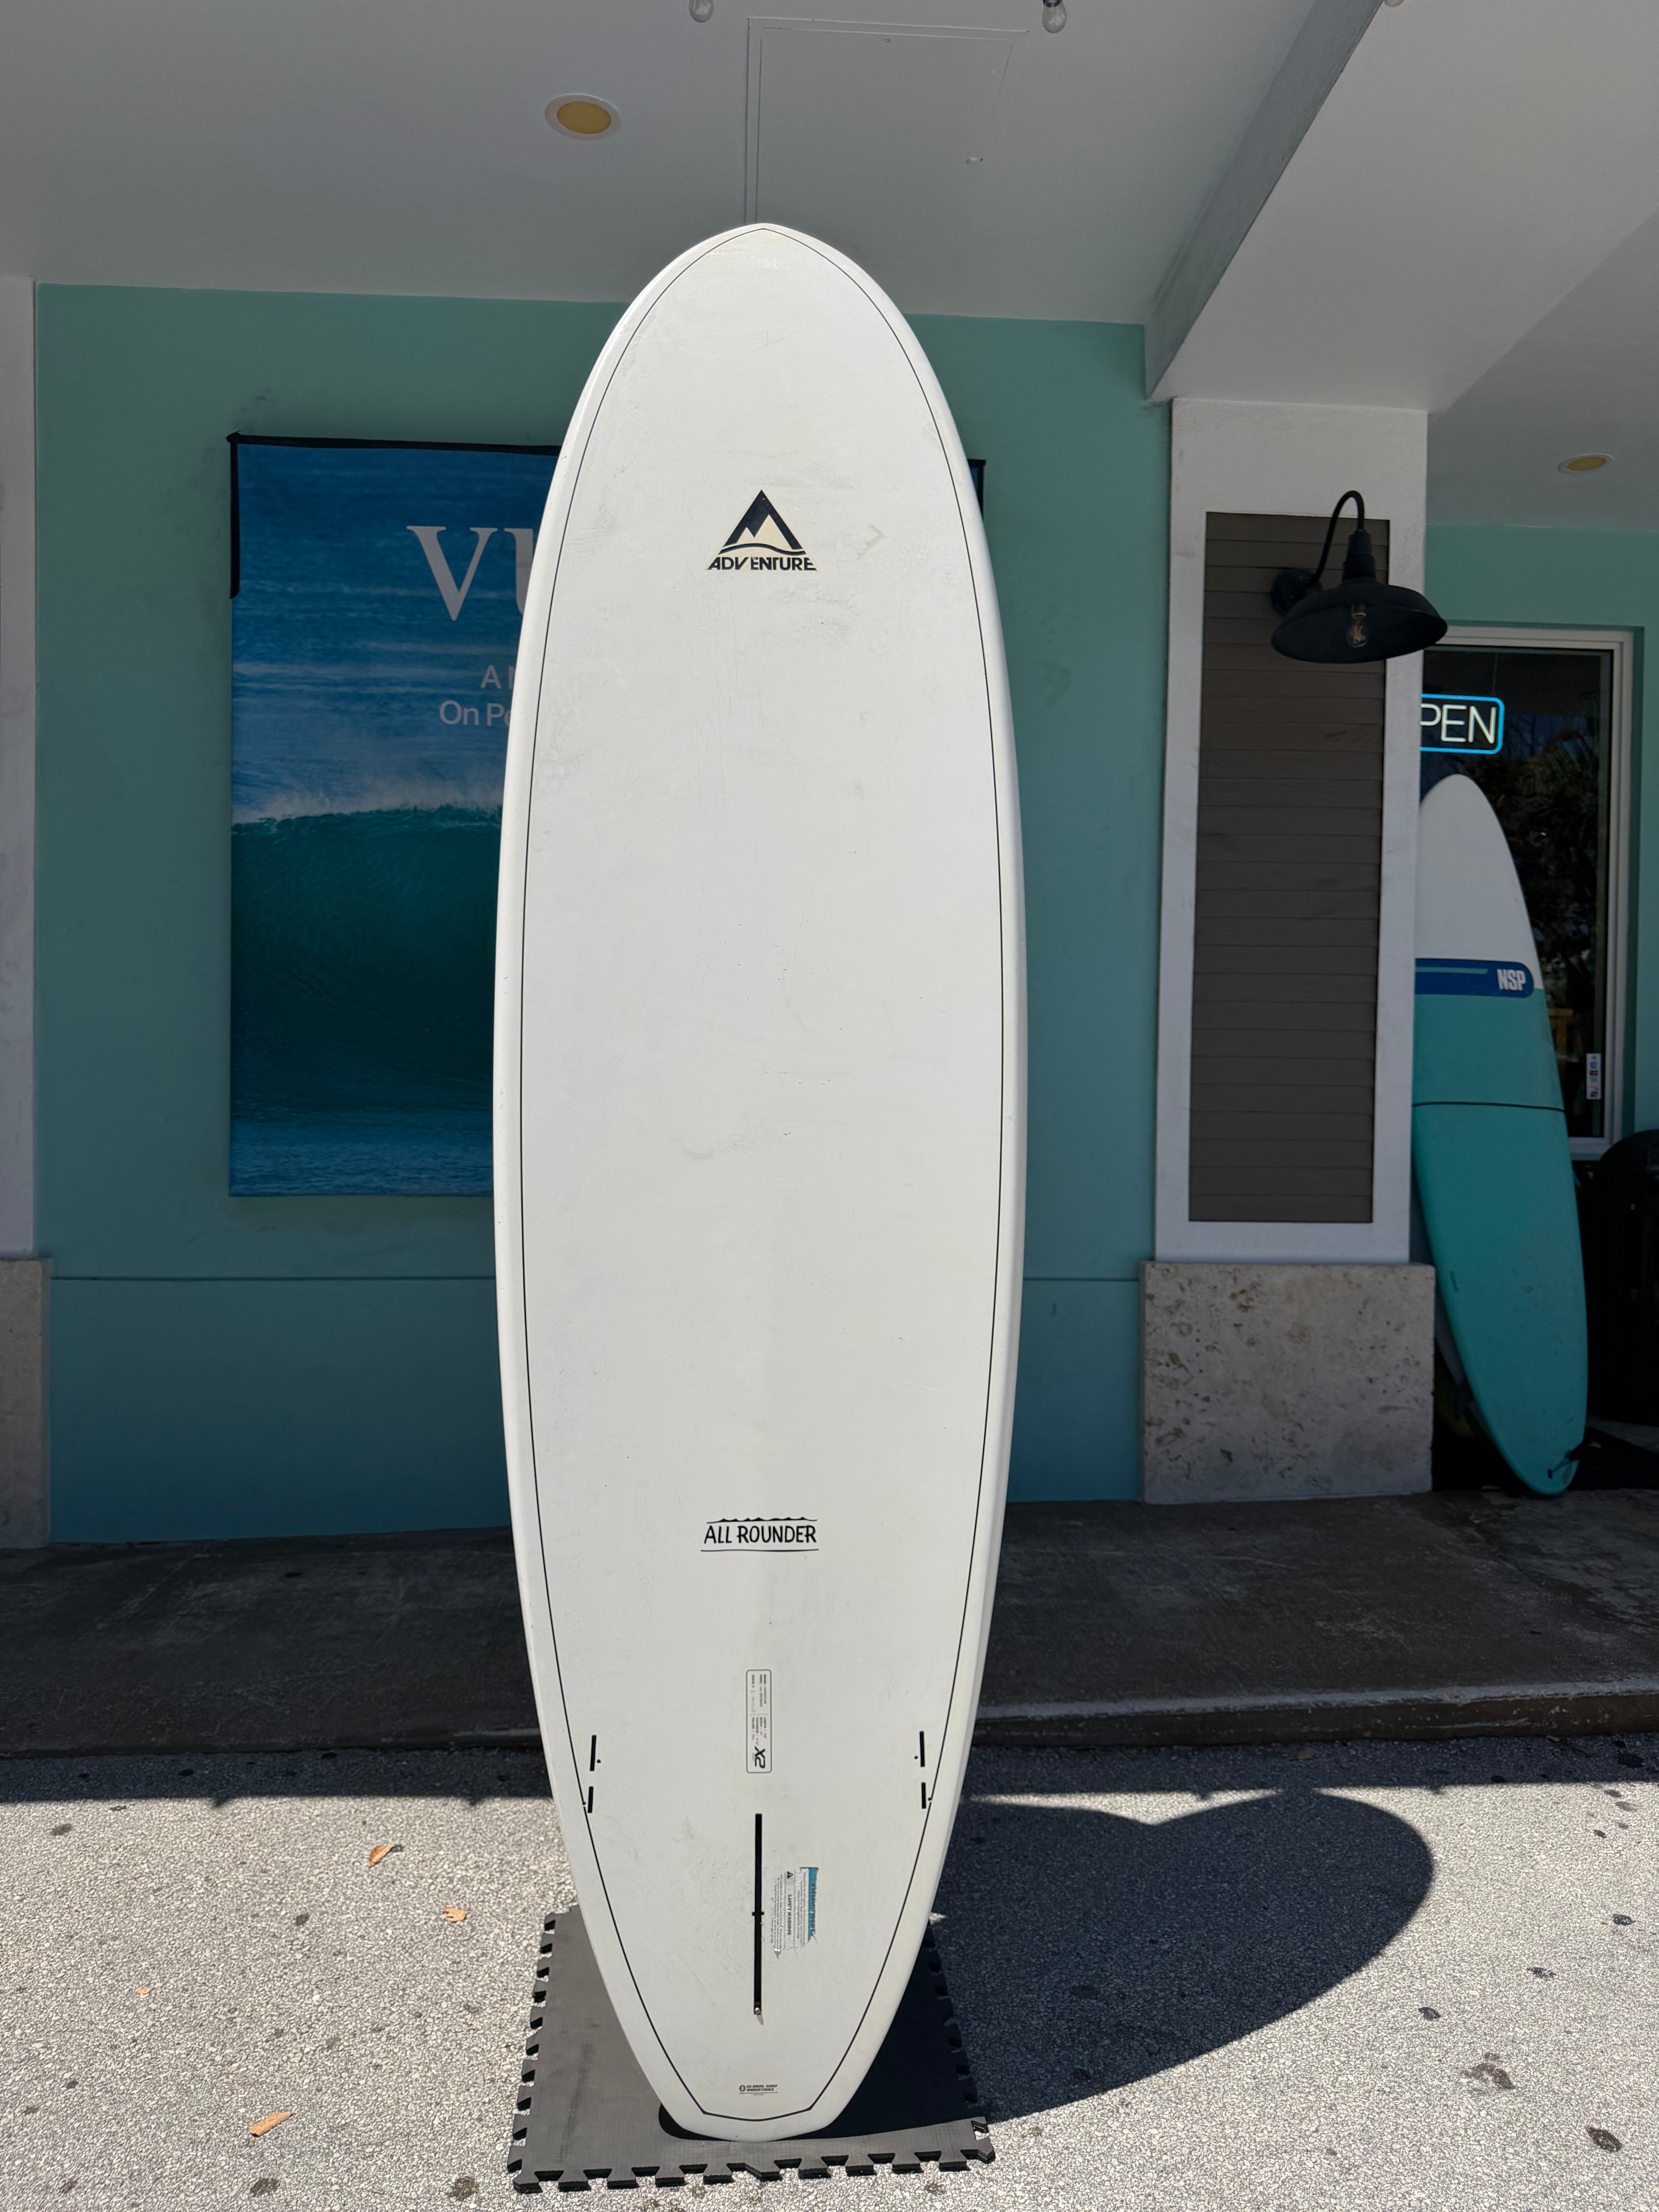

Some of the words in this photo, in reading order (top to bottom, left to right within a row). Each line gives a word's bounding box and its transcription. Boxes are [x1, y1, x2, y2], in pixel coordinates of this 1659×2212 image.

[707, 557, 817, 571] ADVENTURE
[481, 665, 502, 689] A
[440, 701, 479, 725] On
[1497, 969, 1526, 991] NSP
[704, 1525, 732, 1544] ALL
[737, 1525, 816, 1543] ROUNDER
[754, 1746, 766, 1768] X2
